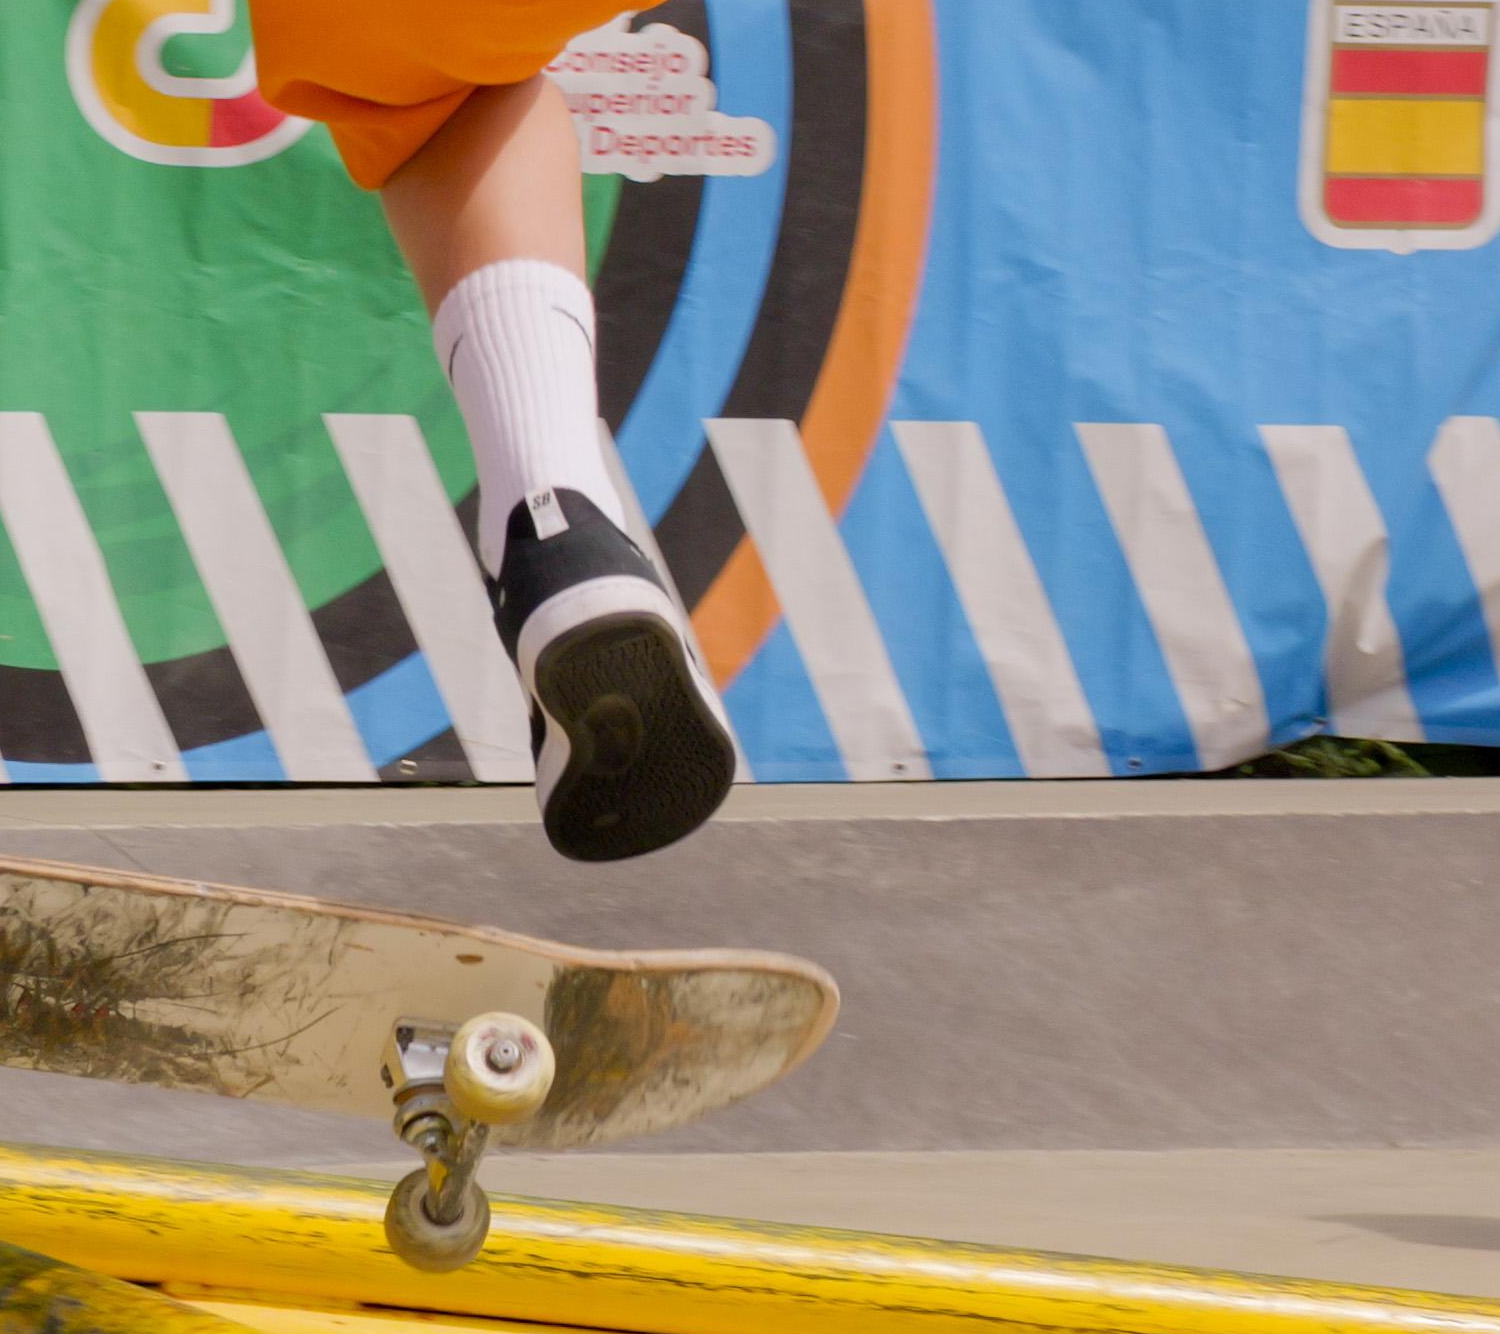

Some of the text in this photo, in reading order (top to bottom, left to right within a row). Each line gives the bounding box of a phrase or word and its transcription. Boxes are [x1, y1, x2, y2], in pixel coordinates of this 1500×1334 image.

[1344, 9, 1479, 40] ESPAÑA
[545, 43, 687, 82] onsejo
[563, 84, 695, 123] uperior
[590, 125, 758, 165] Deportes
